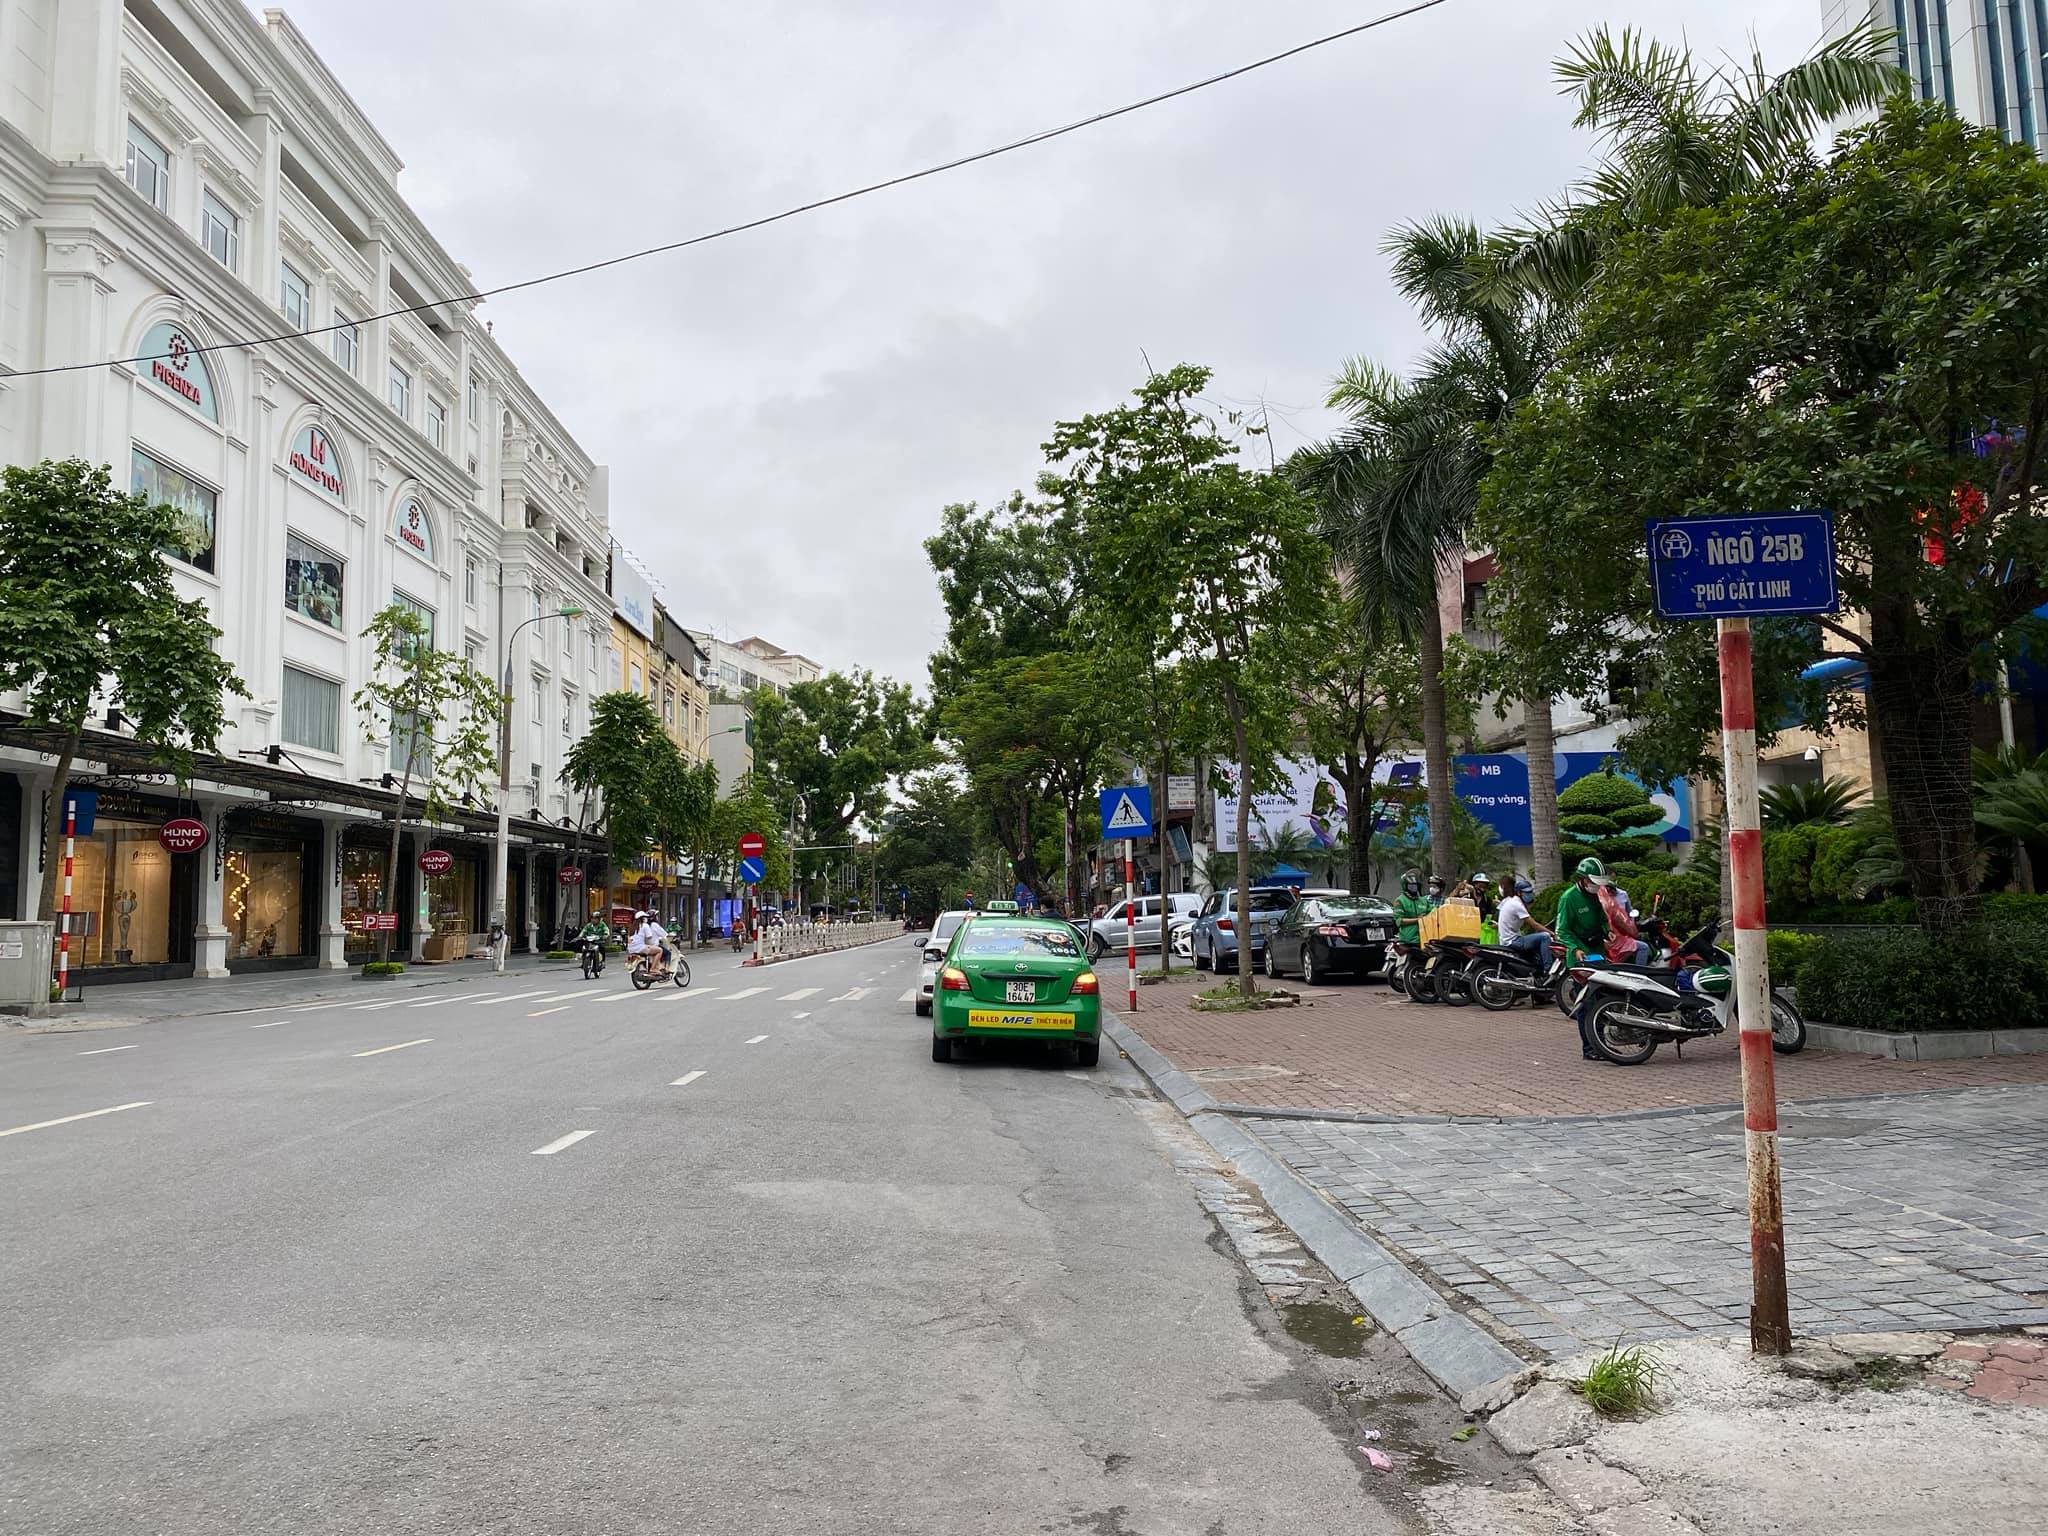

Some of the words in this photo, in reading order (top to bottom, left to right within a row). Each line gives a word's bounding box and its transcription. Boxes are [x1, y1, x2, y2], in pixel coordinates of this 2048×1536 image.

[152, 360, 201, 405] PICENZA
[1707, 530, 1755, 565] NGÕ
[1761, 534, 1804, 563] 25B
[1697, 577, 1725, 602] PHỐ
[1728, 578, 1755, 601] CÁT
[1758, 579, 1791, 599] LINH
[1481, 765, 1501, 776] MB
[1497, 794, 1527, 806] vàng,
[163, 827, 201, 837] HÙNG
[168, 838, 195, 847] TÚY
[366, 916, 377, 929] P
[1013, 982, 1029, 992] 30E
[1002, 1016, 1034, 1025] MPE
